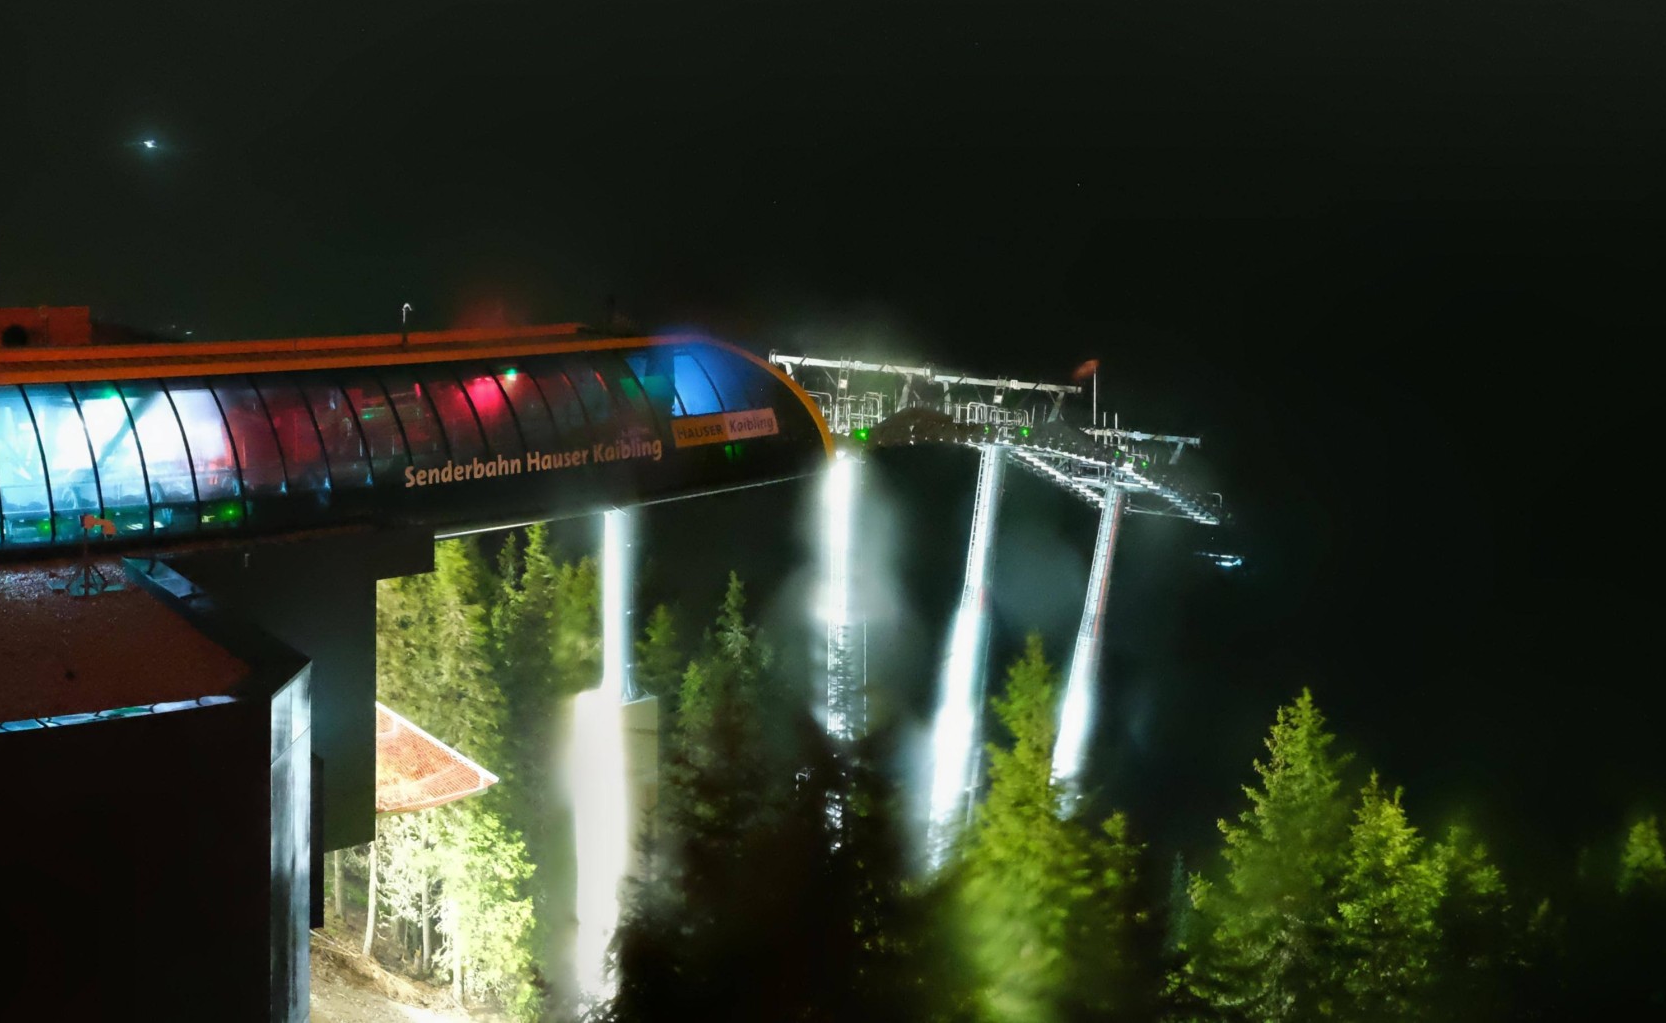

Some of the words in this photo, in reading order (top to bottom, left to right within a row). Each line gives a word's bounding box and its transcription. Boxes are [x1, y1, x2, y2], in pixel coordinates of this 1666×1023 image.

[677, 424, 723, 439] HAUSER
[729, 416, 773, 433] Kaibling
[404, 454, 521, 488] Senderbahn
[526, 448, 589, 473] Hauser
[593, 439, 662, 463] Kaibling
